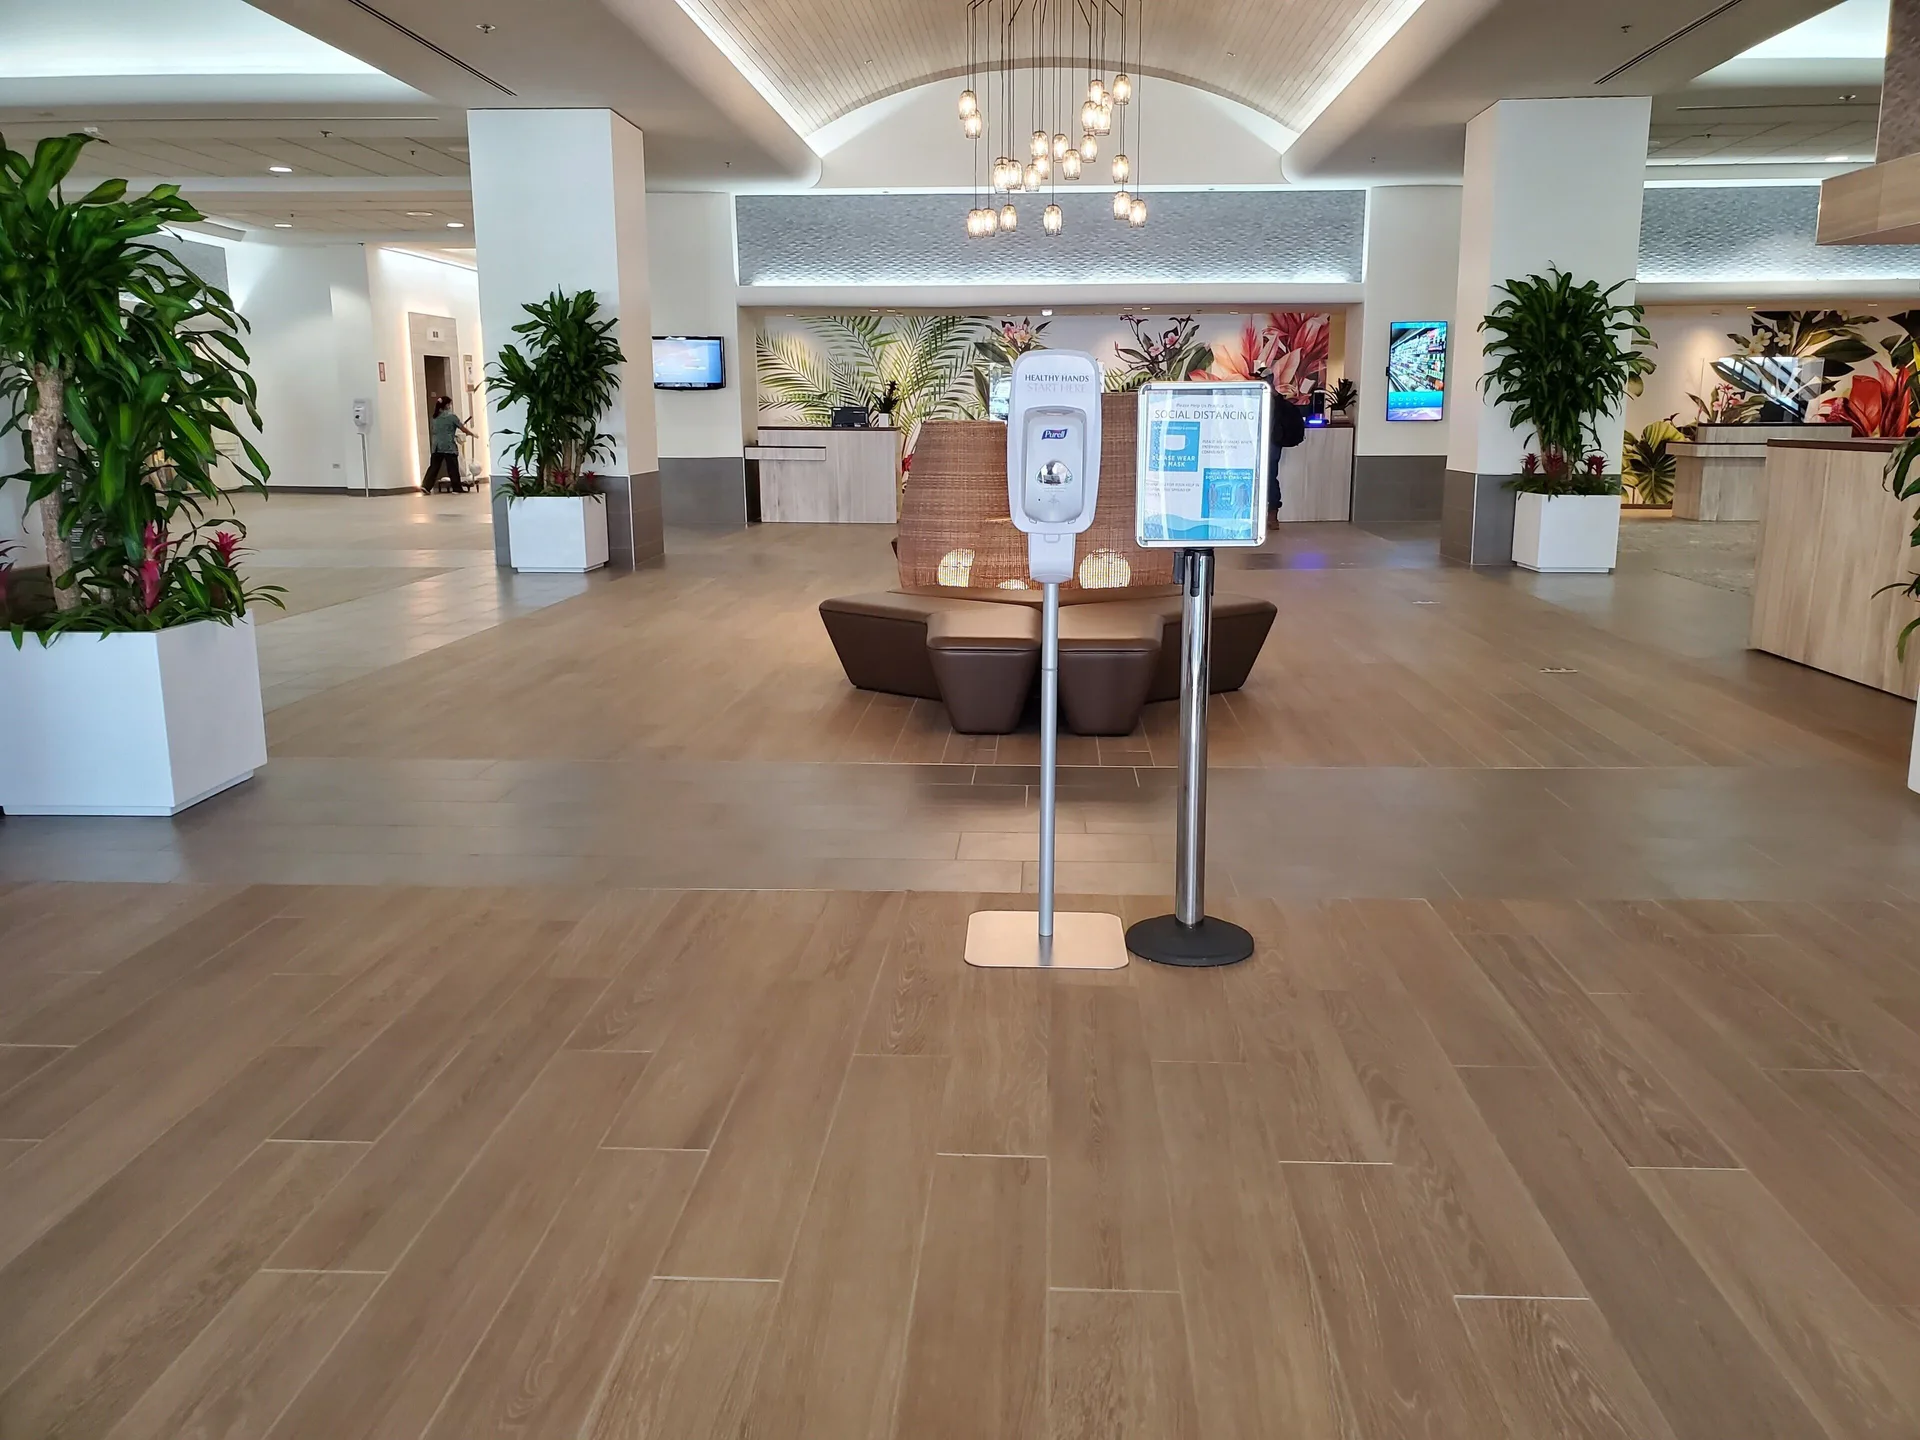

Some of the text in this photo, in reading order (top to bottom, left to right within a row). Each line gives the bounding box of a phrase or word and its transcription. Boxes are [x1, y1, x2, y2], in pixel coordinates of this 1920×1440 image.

[1024, 374, 1060, 382] HEALTHY
[1027, 383, 1085, 393] START HERE
[1154, 410, 1255, 420] SOCIAL DISTANCING
[1044, 429, 1066, 439] Purell
